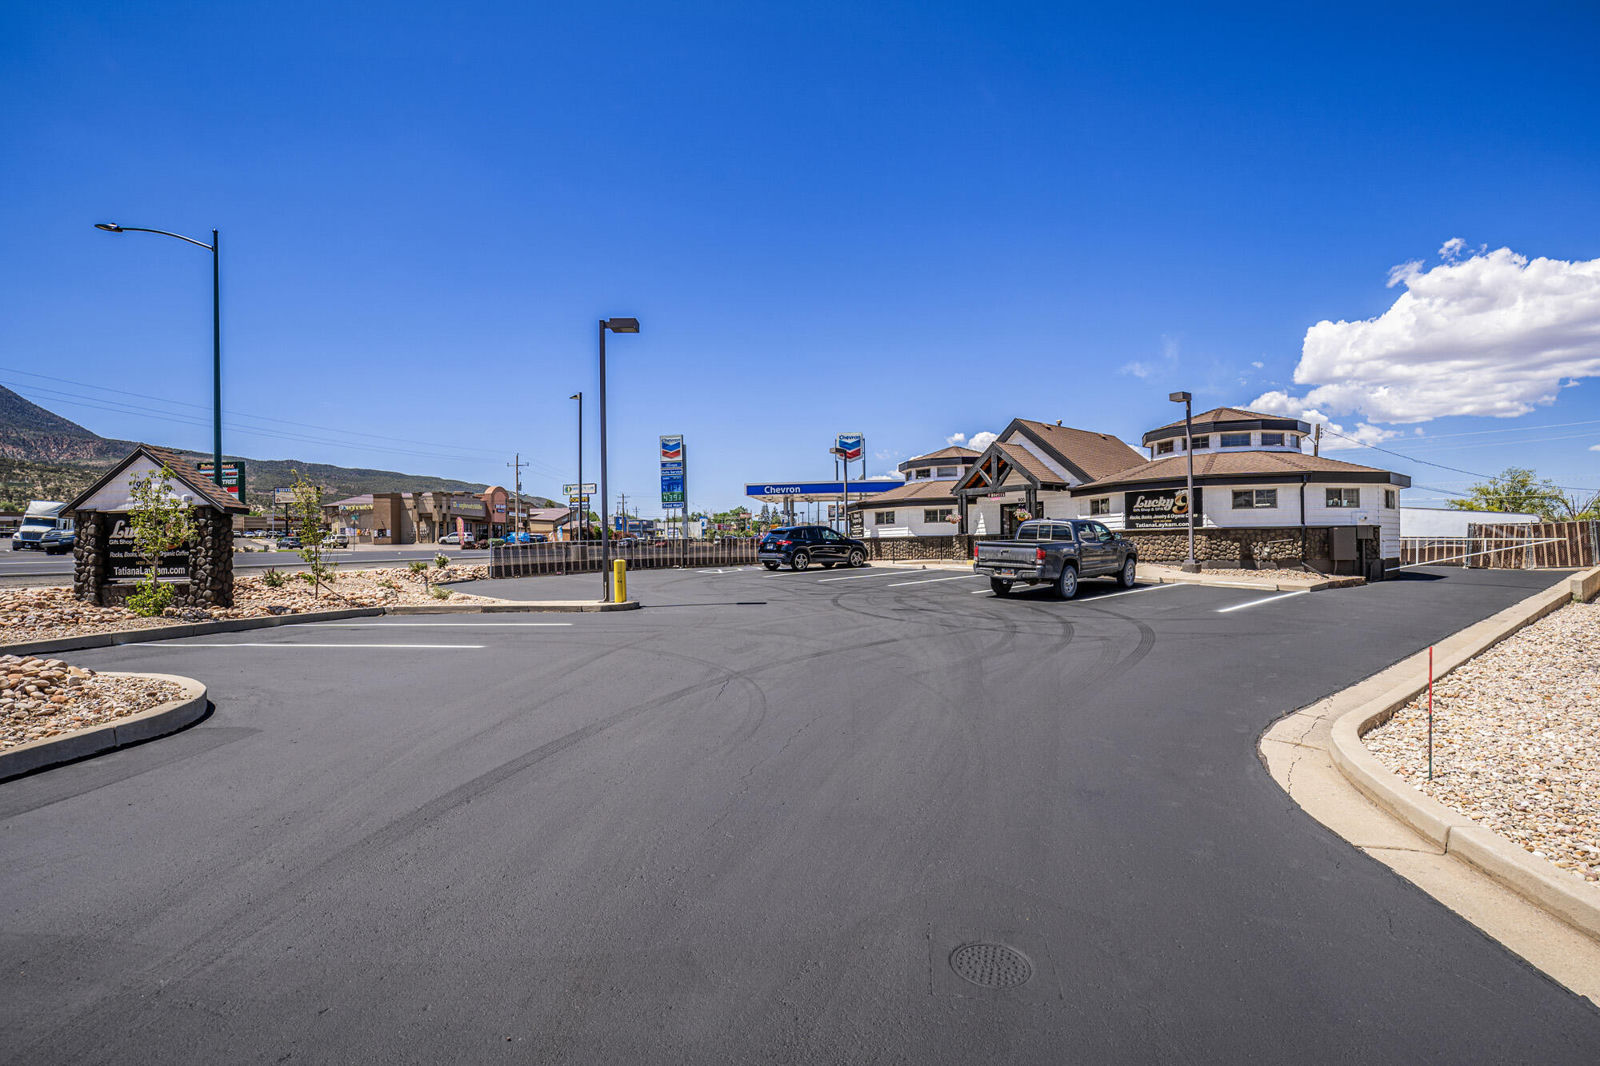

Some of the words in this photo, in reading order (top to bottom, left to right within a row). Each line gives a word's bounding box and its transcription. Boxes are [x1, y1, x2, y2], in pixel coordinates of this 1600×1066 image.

[764, 486, 801, 494] Chevron
[1133, 495, 1174, 511] Lucky
[113, 566, 186, 577] TatianaLayam.com
